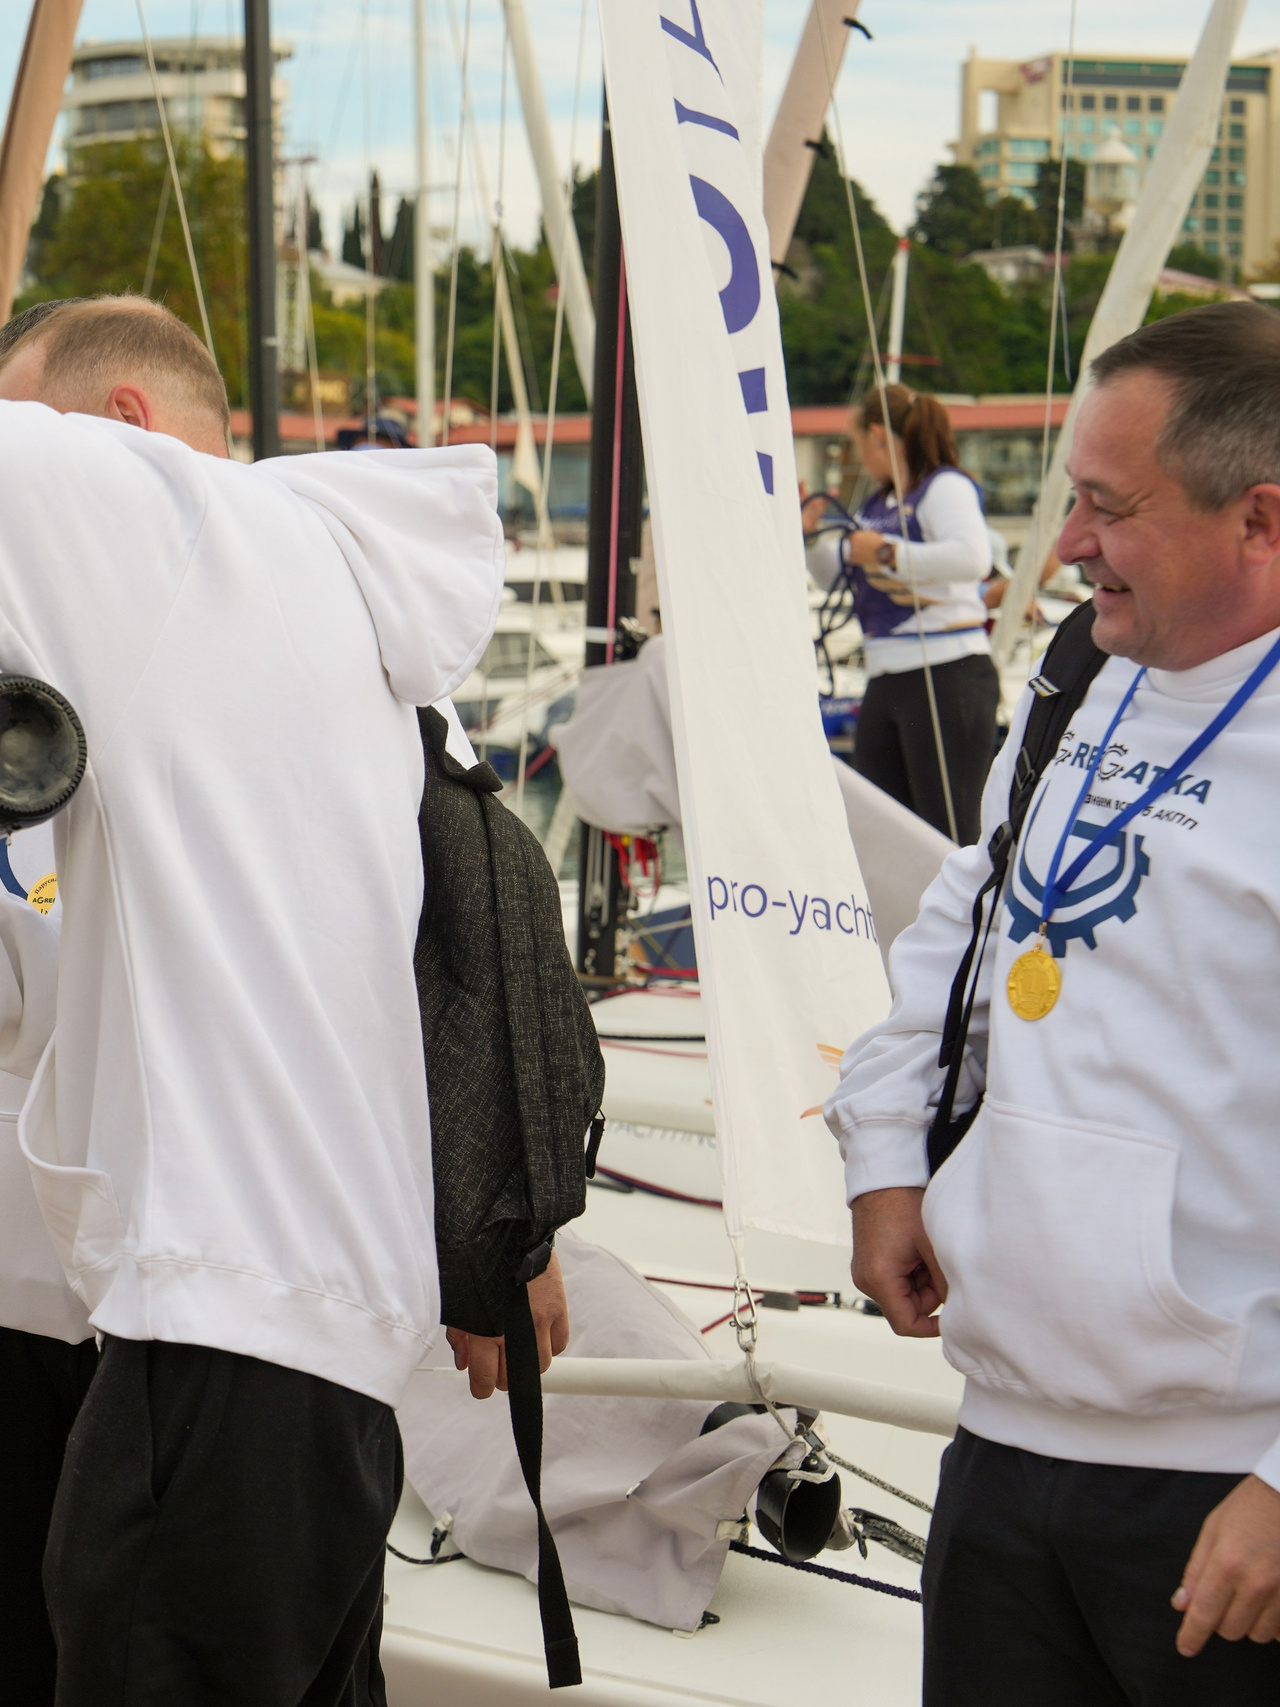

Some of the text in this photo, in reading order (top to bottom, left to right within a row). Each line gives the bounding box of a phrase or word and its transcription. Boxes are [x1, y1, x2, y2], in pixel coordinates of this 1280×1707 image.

[1054, 730, 1212, 804] GREGATKA
[1114, 799, 1131, 811] вс
[32, 896, 56, 905] AGRE
